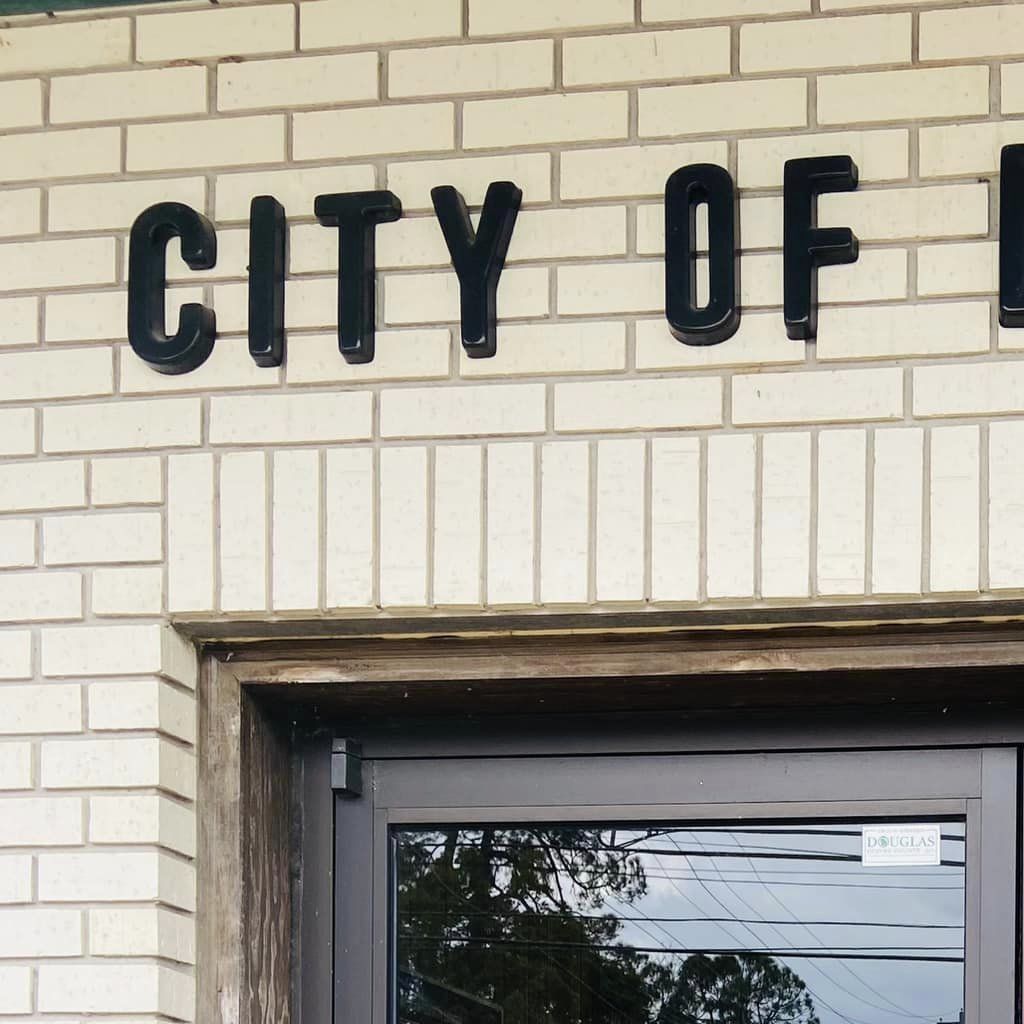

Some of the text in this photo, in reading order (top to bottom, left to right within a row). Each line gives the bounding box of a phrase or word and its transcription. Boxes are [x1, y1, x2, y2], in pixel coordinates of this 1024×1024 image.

[126, 180, 523, 375] CITY
[664, 155, 859, 346] OF
[867, 835, 936, 848] DOUGLAS
